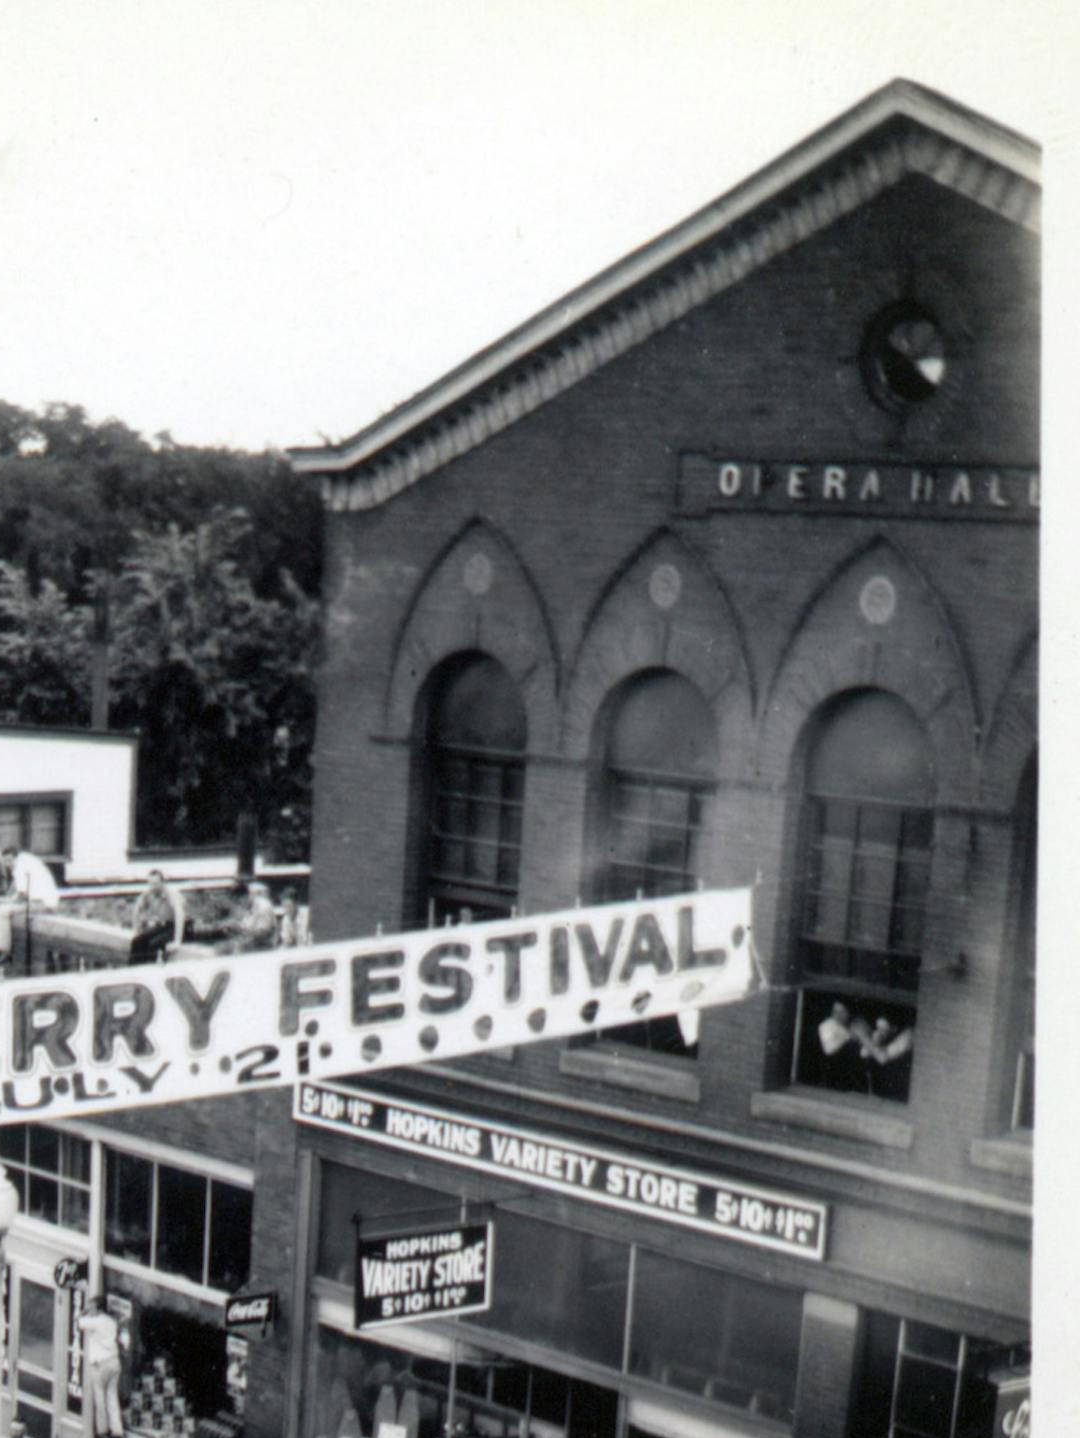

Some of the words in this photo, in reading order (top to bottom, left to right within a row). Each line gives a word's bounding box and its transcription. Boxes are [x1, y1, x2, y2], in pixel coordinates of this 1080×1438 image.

[720, 463, 880, 501] OPERA
[279, 905, 727, 1037] FESTIVAL
[385, 1108, 482, 1156] HOPKINS
[490, 1133, 598, 1187] VARIETY
[605, 1165, 699, 1215] STORE
[361, 1256, 432, 1299] VARIETY
[433, 1241, 485, 1288] STORE
[386, 1231, 463, 1260] HOPKINS
